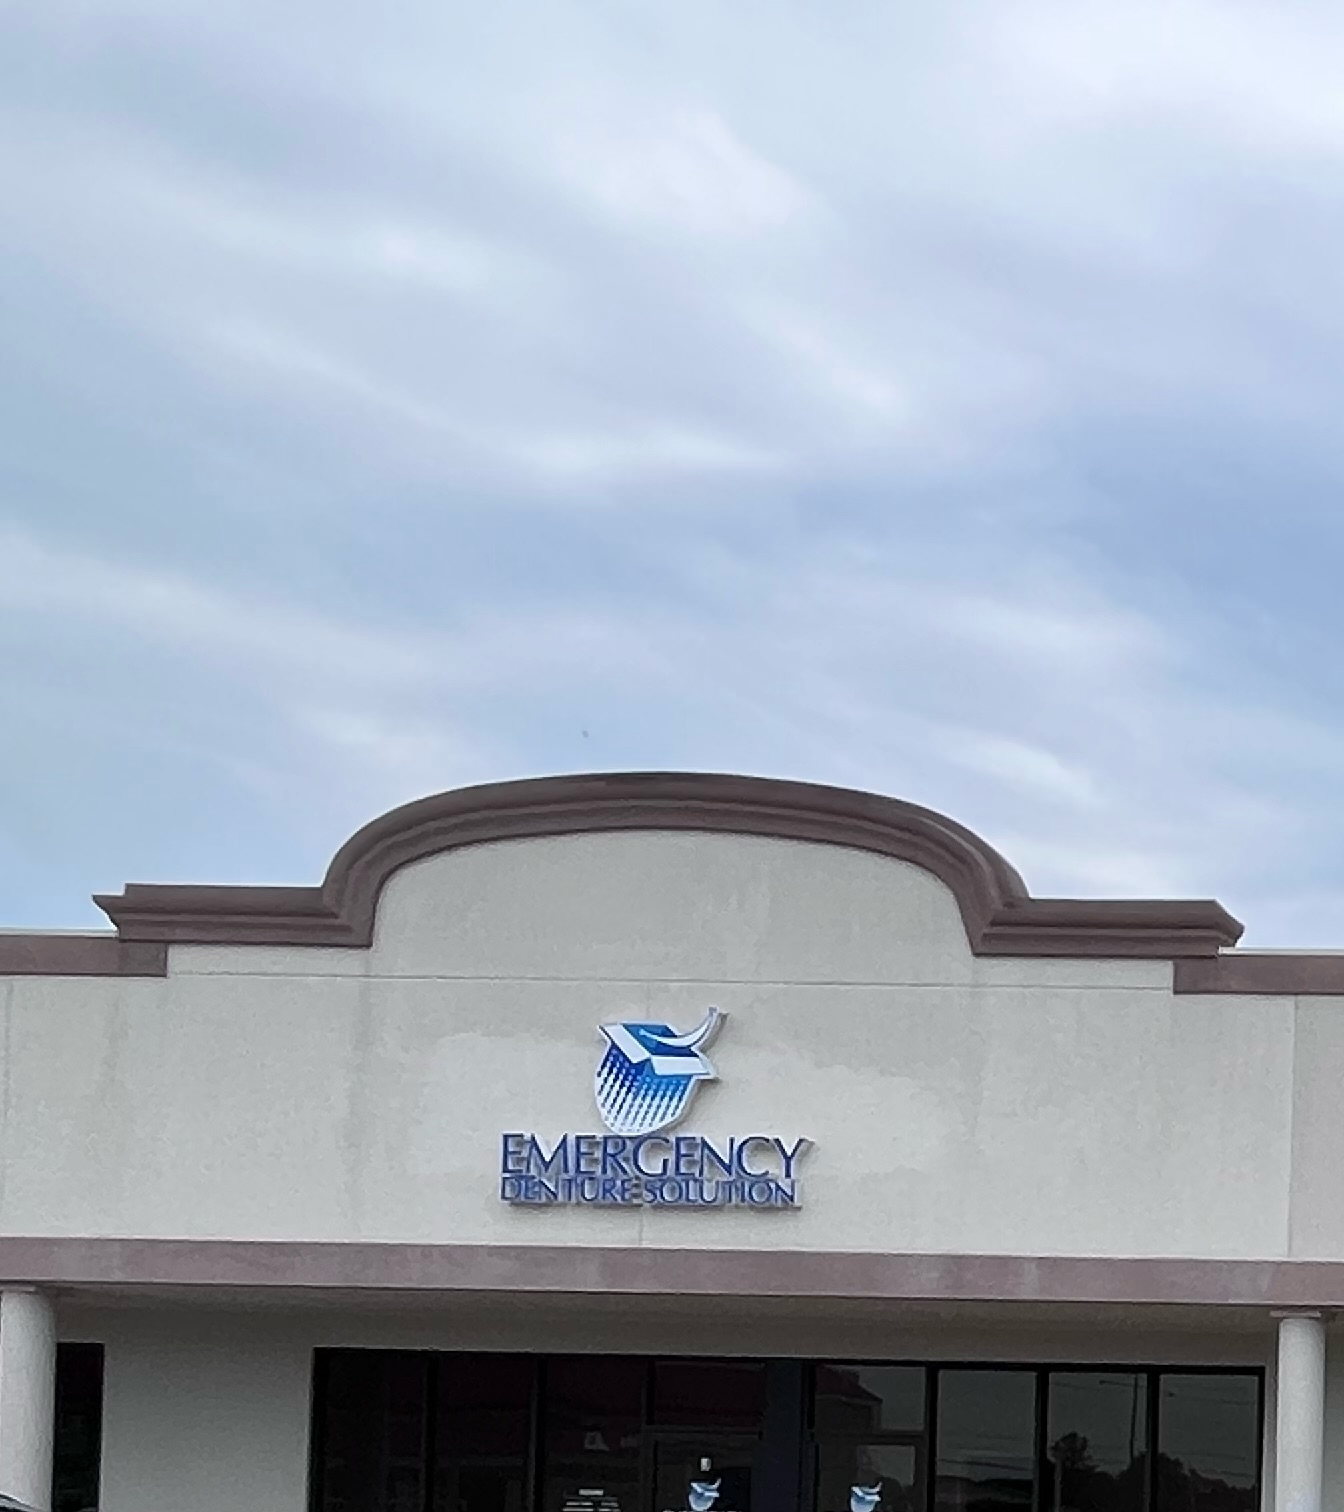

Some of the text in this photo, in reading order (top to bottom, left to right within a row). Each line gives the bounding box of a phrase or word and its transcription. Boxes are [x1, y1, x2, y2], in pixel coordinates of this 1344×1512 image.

[501, 1132, 806, 1179] EMERGENCY
[501, 1175, 795, 1205] DENTURE SOLUTION
